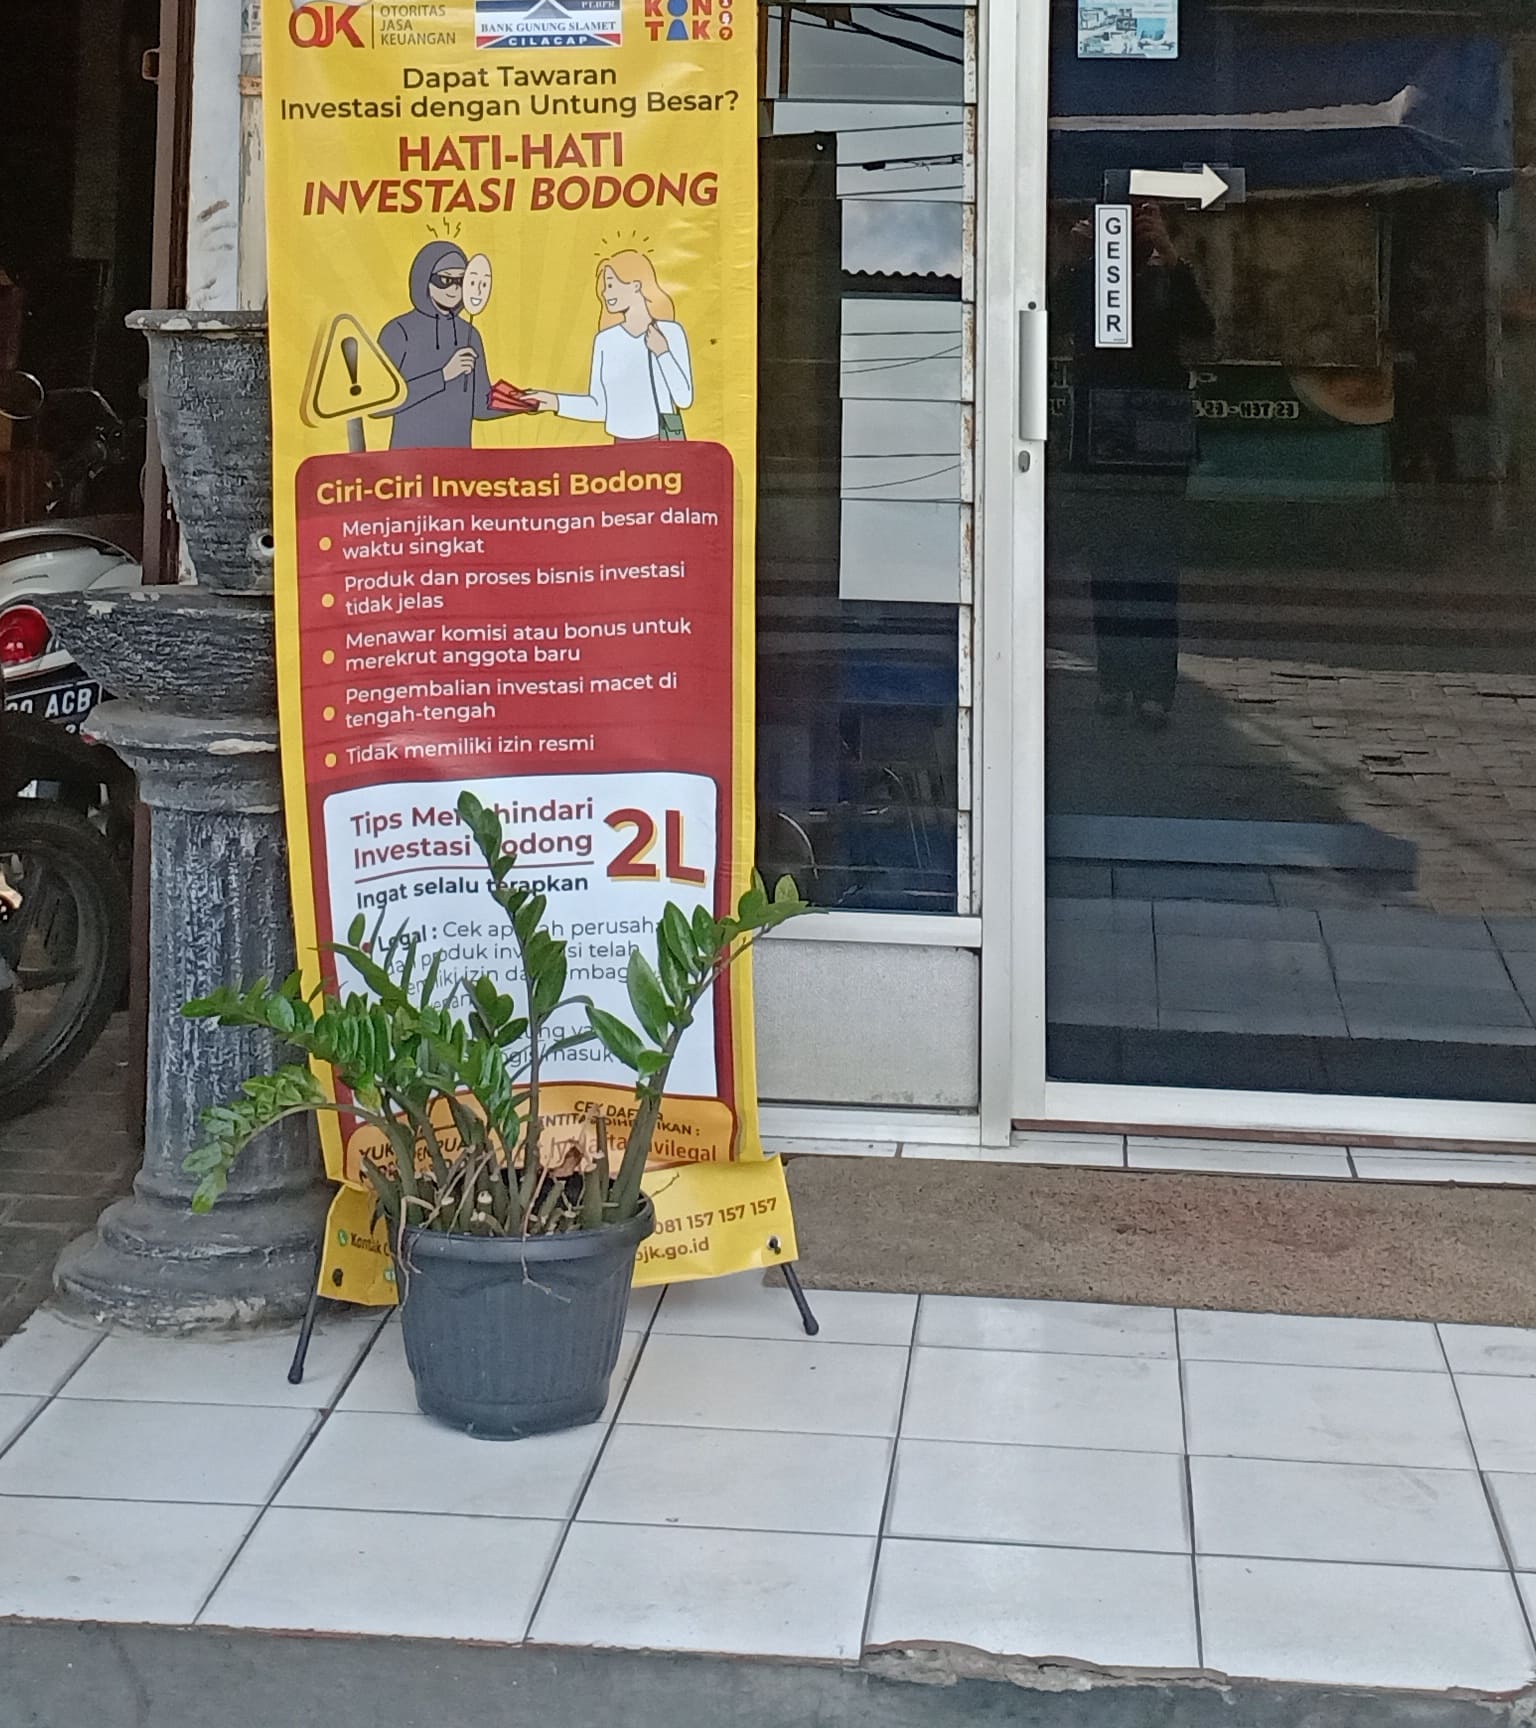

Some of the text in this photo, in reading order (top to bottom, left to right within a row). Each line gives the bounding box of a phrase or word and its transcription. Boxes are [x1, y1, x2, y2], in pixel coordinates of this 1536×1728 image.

[380, 4, 446, 18] OTORITAS
[380, 19, 412, 32] JASA
[380, 32, 456, 47] KEUANGAN
[481, 21, 615, 32] BANK GUNUNG SLAMET
[508, 36, 588, 46] CILACAP
[403, 66, 617, 92] Dapat Tawaran
[281, 90, 738, 122] Investasi dengan Untung Besar?
[399, 132, 623, 171] HATI-HATI
[303, 172, 718, 215] INVESTASI BODONG
[1105, 216, 1122, 334] GESER
[316, 470, 682, 505] Ciri-Ciri Investasi Bodong
[342, 507, 718, 538] Menjanjikan keuntungan besar dalam
[343, 536, 484, 560] waktu singkat
[345, 561, 685, 592] Produk dan proses bisnis investasi
[345, 592, 444, 616] tidak jelas
[346, 617, 691, 649] Menawar komisi atau bonus untuk
[345, 644, 580, 671] merekrut anggota baru
[346, 672, 677, 705] Pengembalian investasi macet di
[345, 702, 495, 729] tengah-tengah
[346, 735, 594, 766] Tidak memiliki izin resmi
[350, 808, 402, 838] Tips
[354, 835, 471, 869] Investasi
[357, 879, 407, 910] Ingat
[414, 873, 479, 897] selalu
[443, 921, 482, 937] Cek
[687, 1212, 713, 1227] 157
[718, 1205, 745, 1223] 157
[750, 1197, 777, 1216] 157
